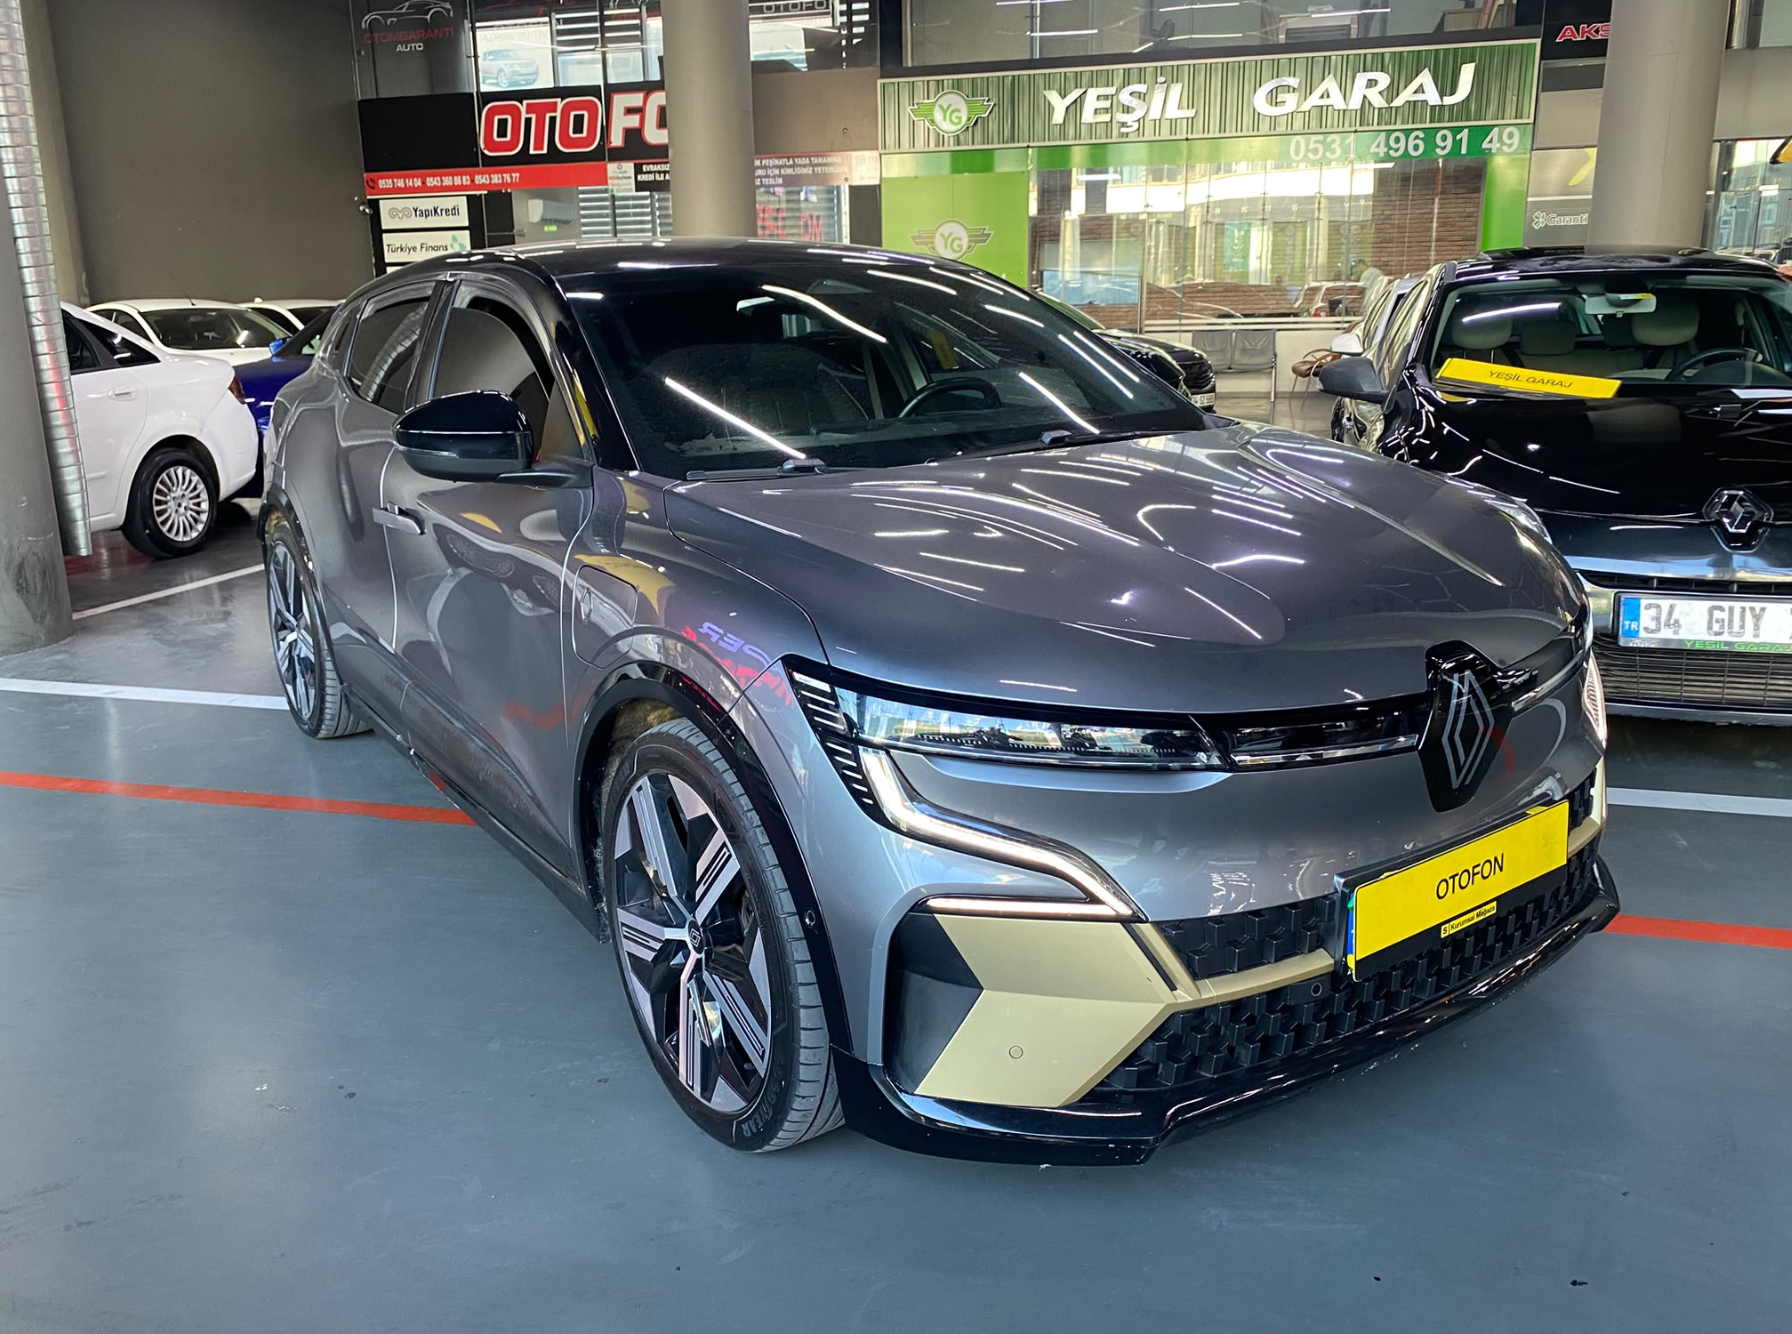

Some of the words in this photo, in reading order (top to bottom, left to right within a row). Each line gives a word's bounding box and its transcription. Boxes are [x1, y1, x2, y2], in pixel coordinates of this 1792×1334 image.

[1555, 22, 1611, 42] AKS
[396, 42, 424, 52] AUTO
[1043, 76, 1197, 133] YEŞİL
[1252, 62, 1476, 118] GARAJ
[938, 103, 963, 126] YG
[1289, 134, 1356, 161] 0531
[1369, 130, 1425, 157] 496
[1435, 128, 1468, 155] 91
[1481, 126, 1521, 153] 49
[386, 243, 418, 255] Türkiye
[420, 242, 448, 252] Finans
[939, 232, 963, 254] YG
[1489, 370, 1522, 383] YEŞİL
[1527, 376, 1574, 389] GARAJ
[1624, 620, 1639, 631] TR
[1643, 602, 1682, 636] 34
[1707, 605, 1767, 638] GUY
[1435, 852, 1505, 901] OTOFON
[1450, 913, 1475, 931] Kurumsal
